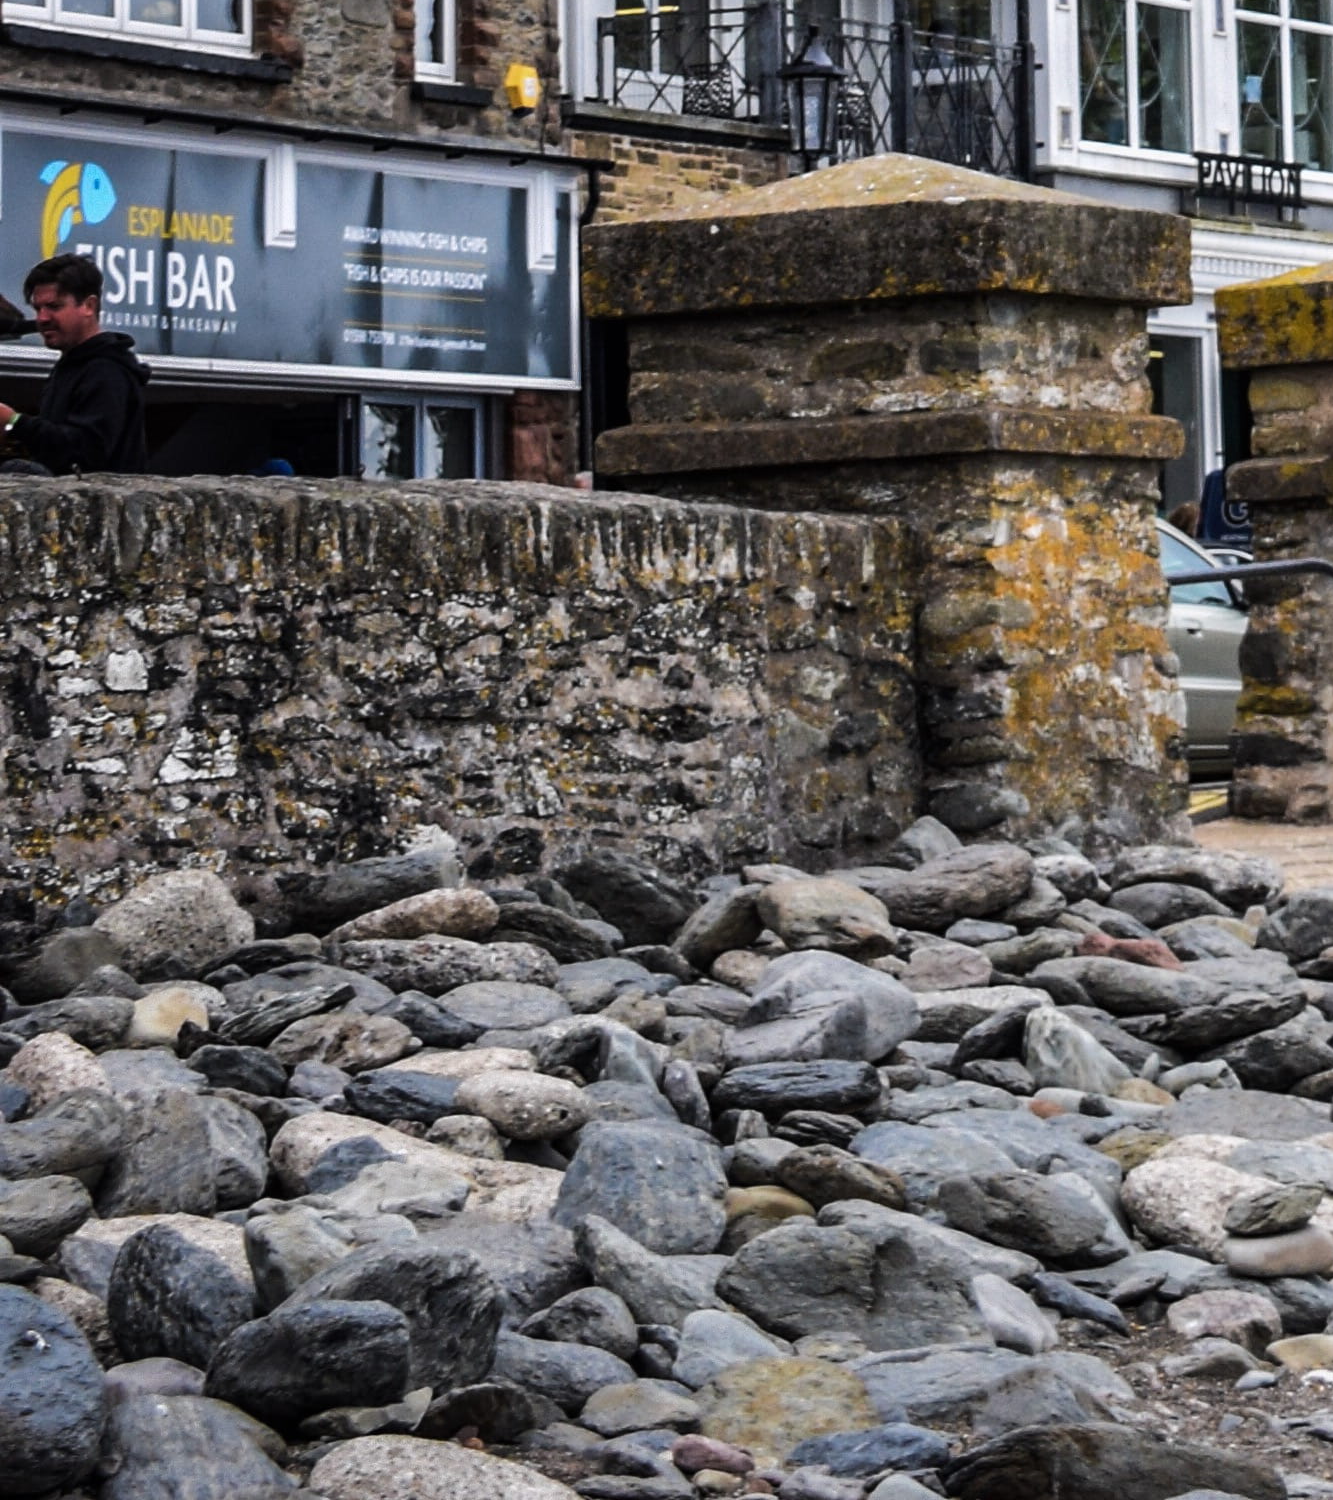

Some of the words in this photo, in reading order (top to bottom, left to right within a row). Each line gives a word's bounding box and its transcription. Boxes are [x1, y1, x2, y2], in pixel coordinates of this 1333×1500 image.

[1199, 156, 1301, 197] PAVILION
[128, 206, 235, 244] ESPLANADE
[381, 228, 426, 248] WINNING
[428, 232, 448, 250] FISH
[450, 235, 459, 251] &
[461, 236, 488, 254] CHIPS
[167, 252, 237, 312] BAR
[370, 266, 379, 282] &
[381, 266, 408, 285] CHIPS
[410, 269, 419, 286] IS
[421, 269, 441, 287] OUR
[99, 310, 158, 329] TAURANT
[160, 317, 170, 330] &
[172, 316, 237, 334] TAKEAWAY
